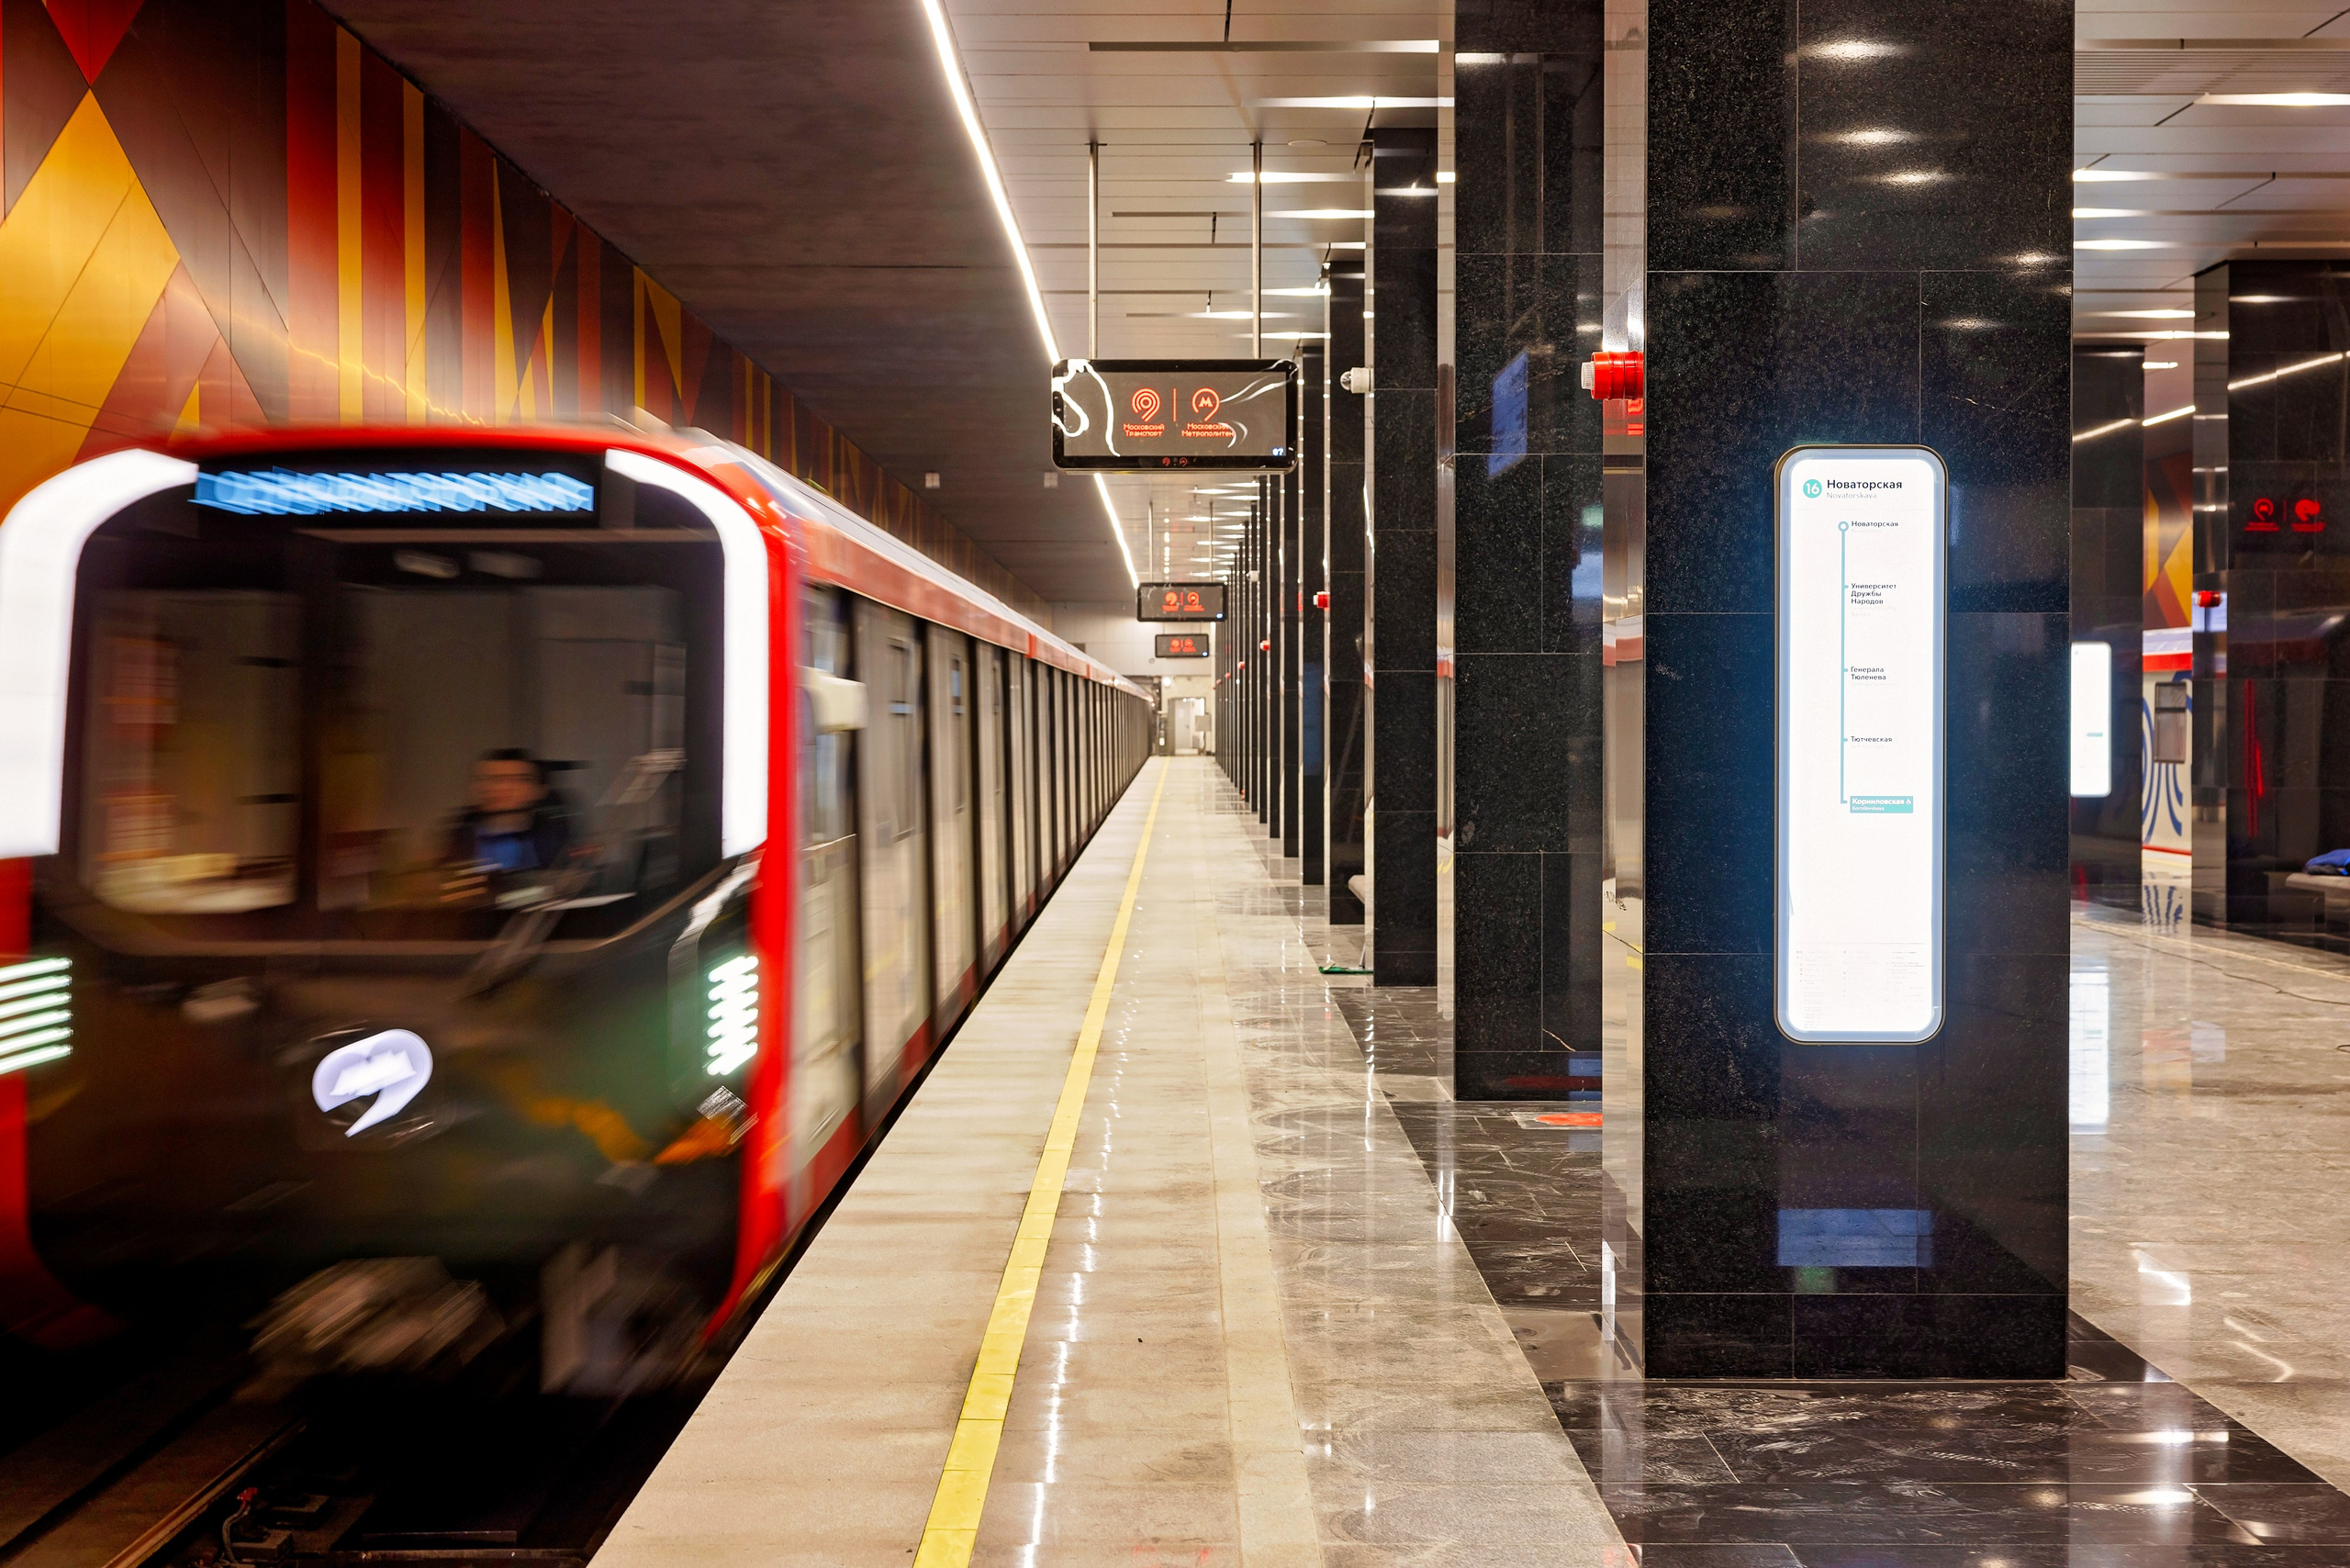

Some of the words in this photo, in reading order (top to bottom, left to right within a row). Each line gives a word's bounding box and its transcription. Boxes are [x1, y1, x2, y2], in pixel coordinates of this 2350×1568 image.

[1805, 483, 1820, 495] 16
[1827, 479, 1903, 491] Новаторская
[1851, 582, 1897, 590] Университет
[1852, 798, 1905, 806] Корниловская
